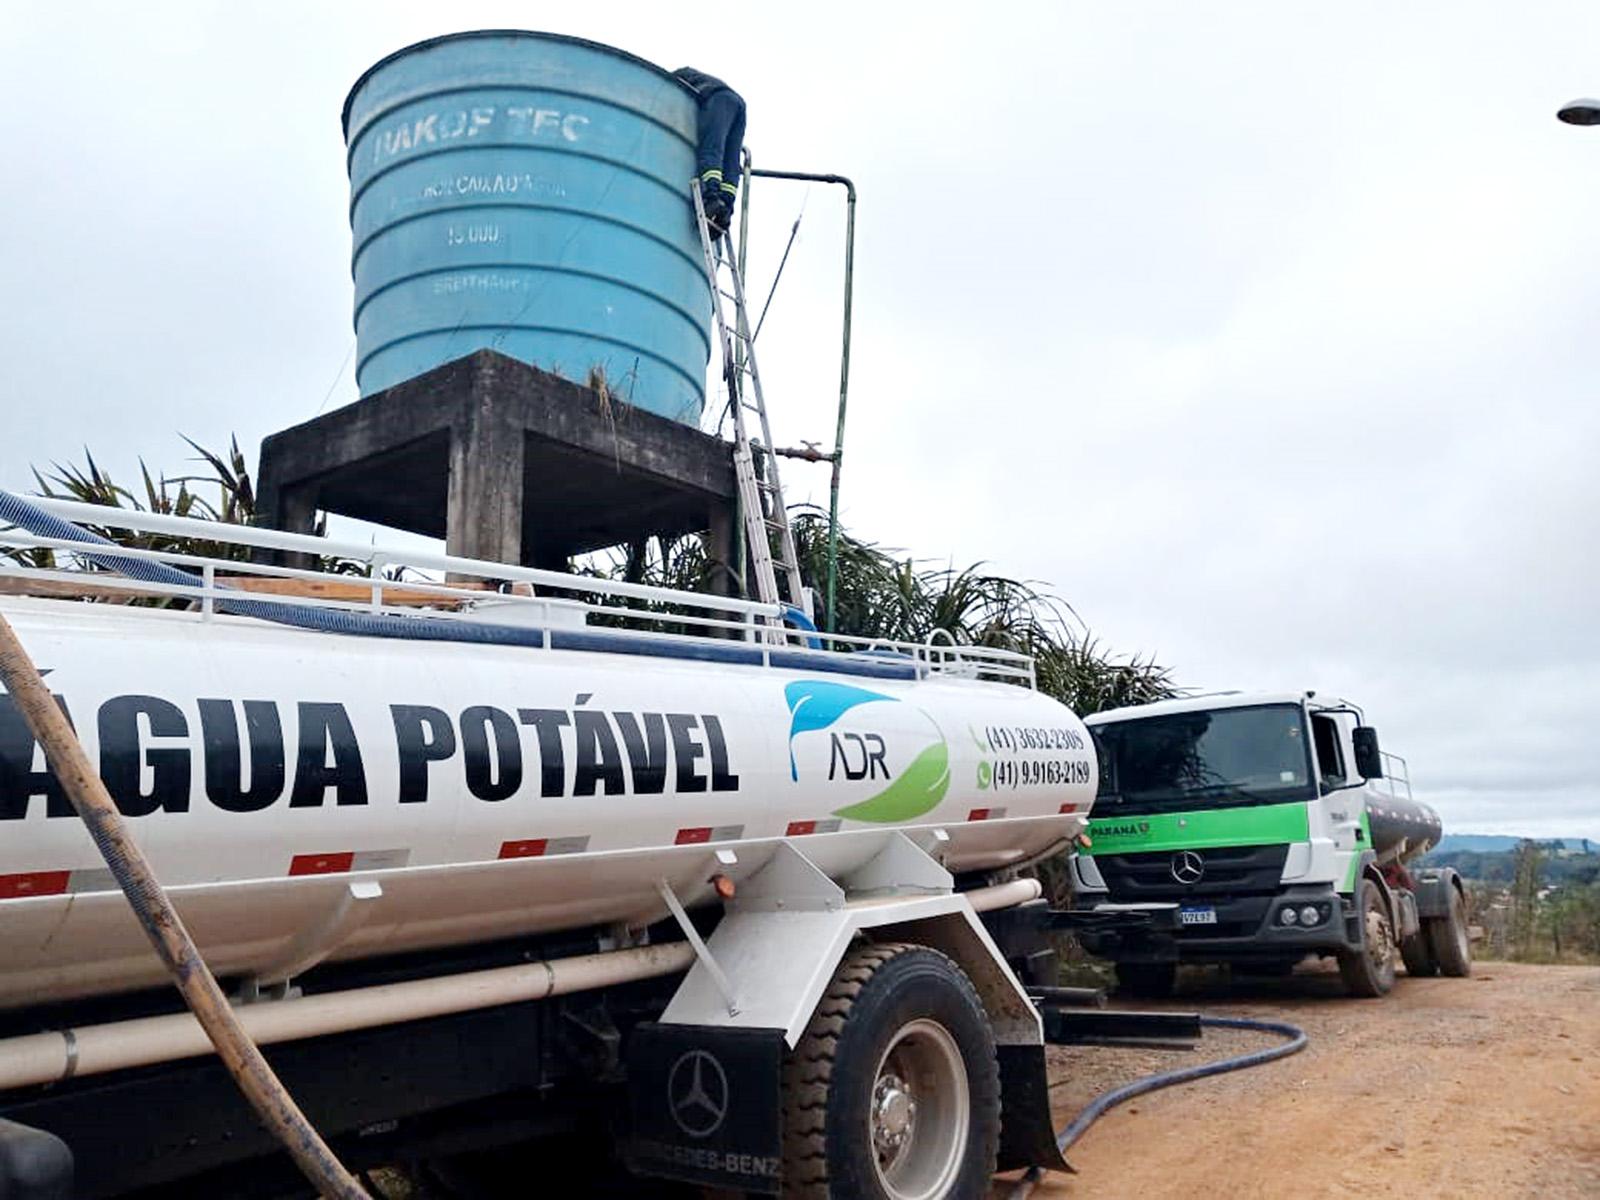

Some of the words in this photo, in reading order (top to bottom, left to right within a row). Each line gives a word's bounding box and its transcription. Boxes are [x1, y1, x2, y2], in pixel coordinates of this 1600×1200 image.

[390, 693, 740, 803] POTÁVEL
[828, 732, 892, 780] ADR
[985, 726, 1017, 753] (41)
[993, 760, 1018, 791] (41)
[1022, 760, 1090, 784] 9.9163-2189
